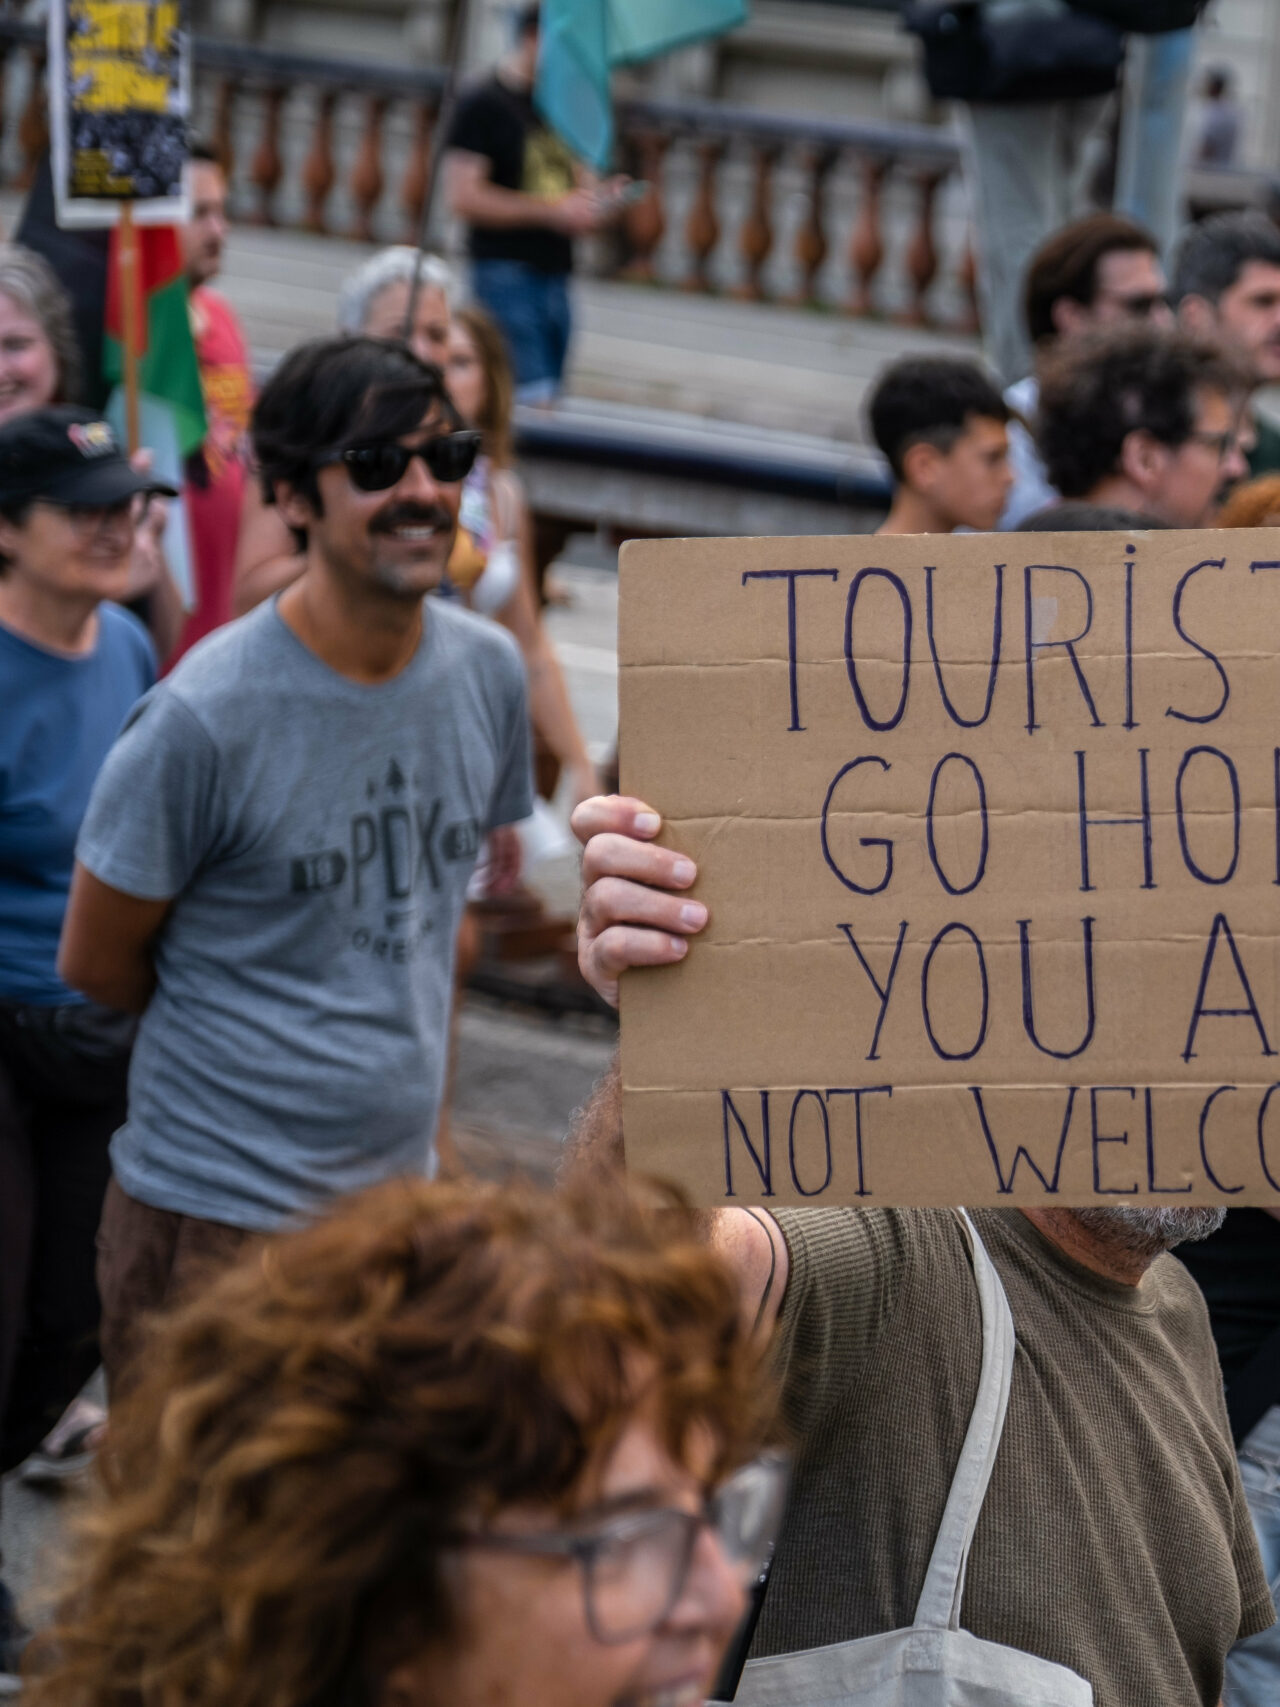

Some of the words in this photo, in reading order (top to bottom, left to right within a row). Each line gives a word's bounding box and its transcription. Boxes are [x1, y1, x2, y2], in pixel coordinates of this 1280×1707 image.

[351, 799, 442, 908] PDX
[820, 750, 988, 896] GO
[838, 918, 1095, 1062] YOU
[722, 1085, 893, 1197] NOT
